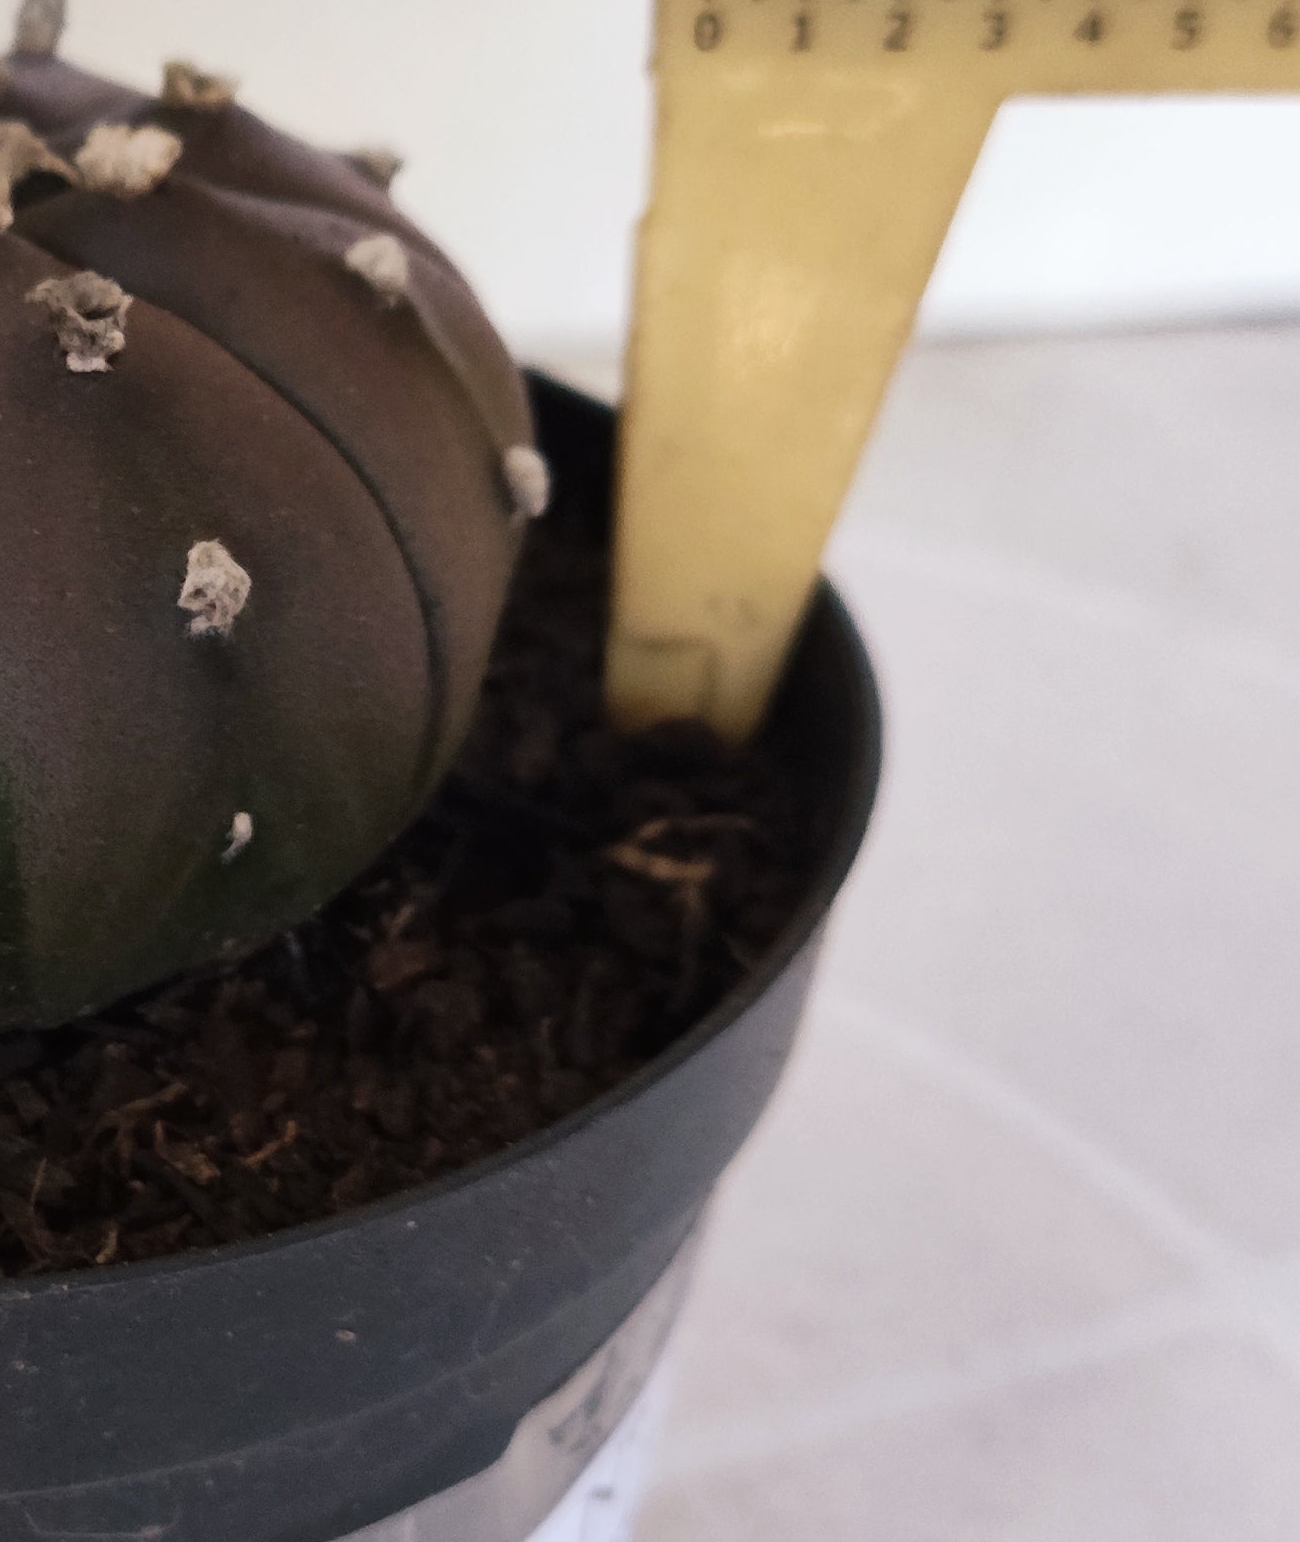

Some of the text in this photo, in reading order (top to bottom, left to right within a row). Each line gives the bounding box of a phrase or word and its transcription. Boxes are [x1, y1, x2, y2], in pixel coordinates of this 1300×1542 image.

[694, 10, 723, 51] 0
[789, 10, 812, 52] 1
[883, 10, 913, 52] 2
[979, 10, 1009, 51] 3
[1074, 10, 1105, 48] 4
[1172, 8, 1200, 50] 5
